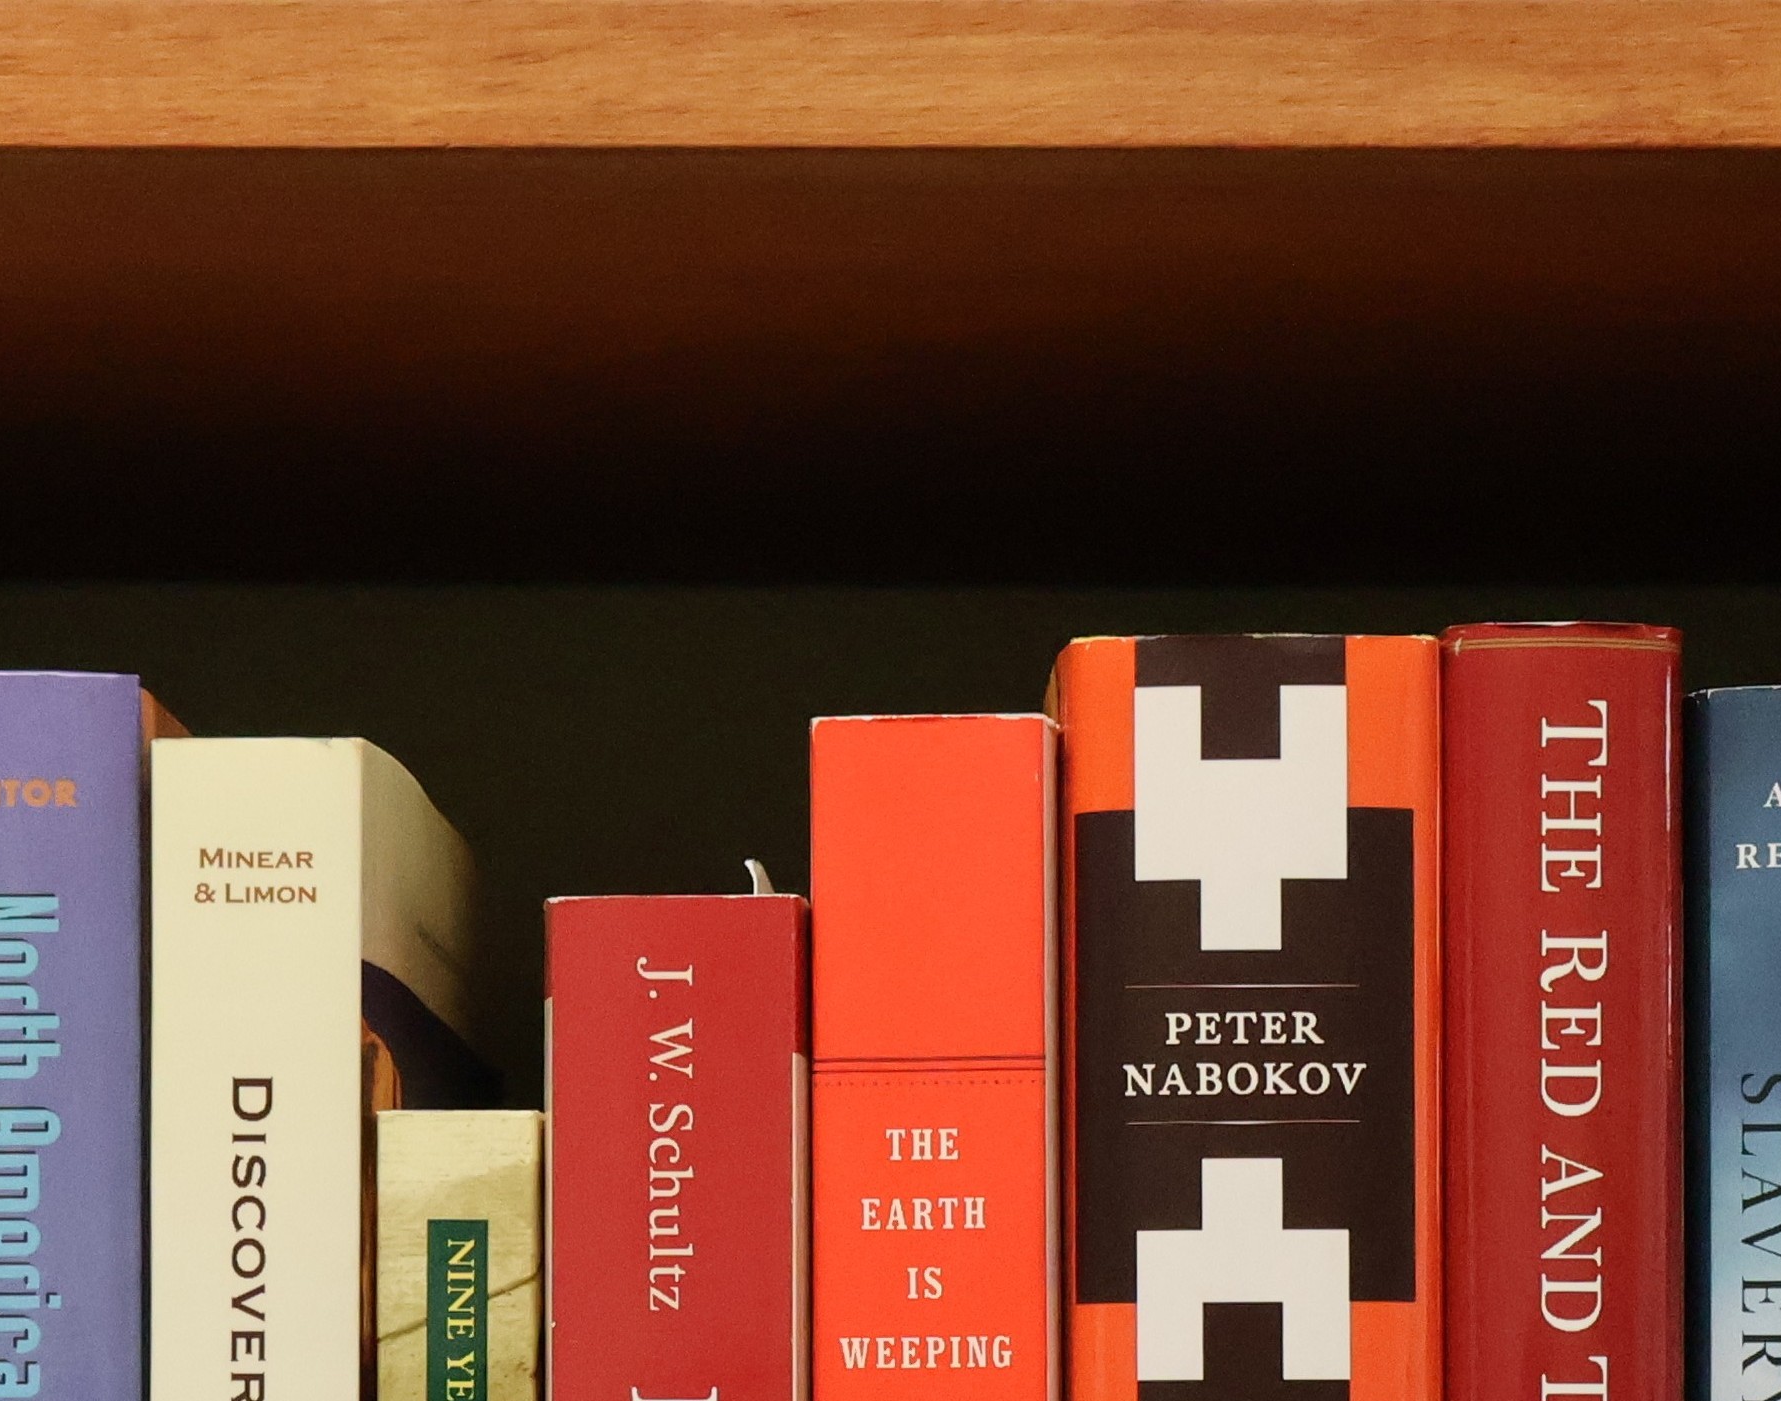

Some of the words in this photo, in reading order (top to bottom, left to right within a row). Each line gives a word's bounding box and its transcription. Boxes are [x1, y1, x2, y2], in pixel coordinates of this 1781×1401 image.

[1542, 700, 1607, 892] THE
[637, 957, 692, 998] J.
[1541, 929, 1607, 1116] RED
[650, 1018, 692, 1080] W.
[1165, 1012, 1324, 1044] PETER
[1123, 1063, 1366, 1096] NABOKOV
[649, 1104, 693, 1310] Schultz
[1541, 1144, 1603, 1331] AND
[447, 1239, 474, 1339] NINE
